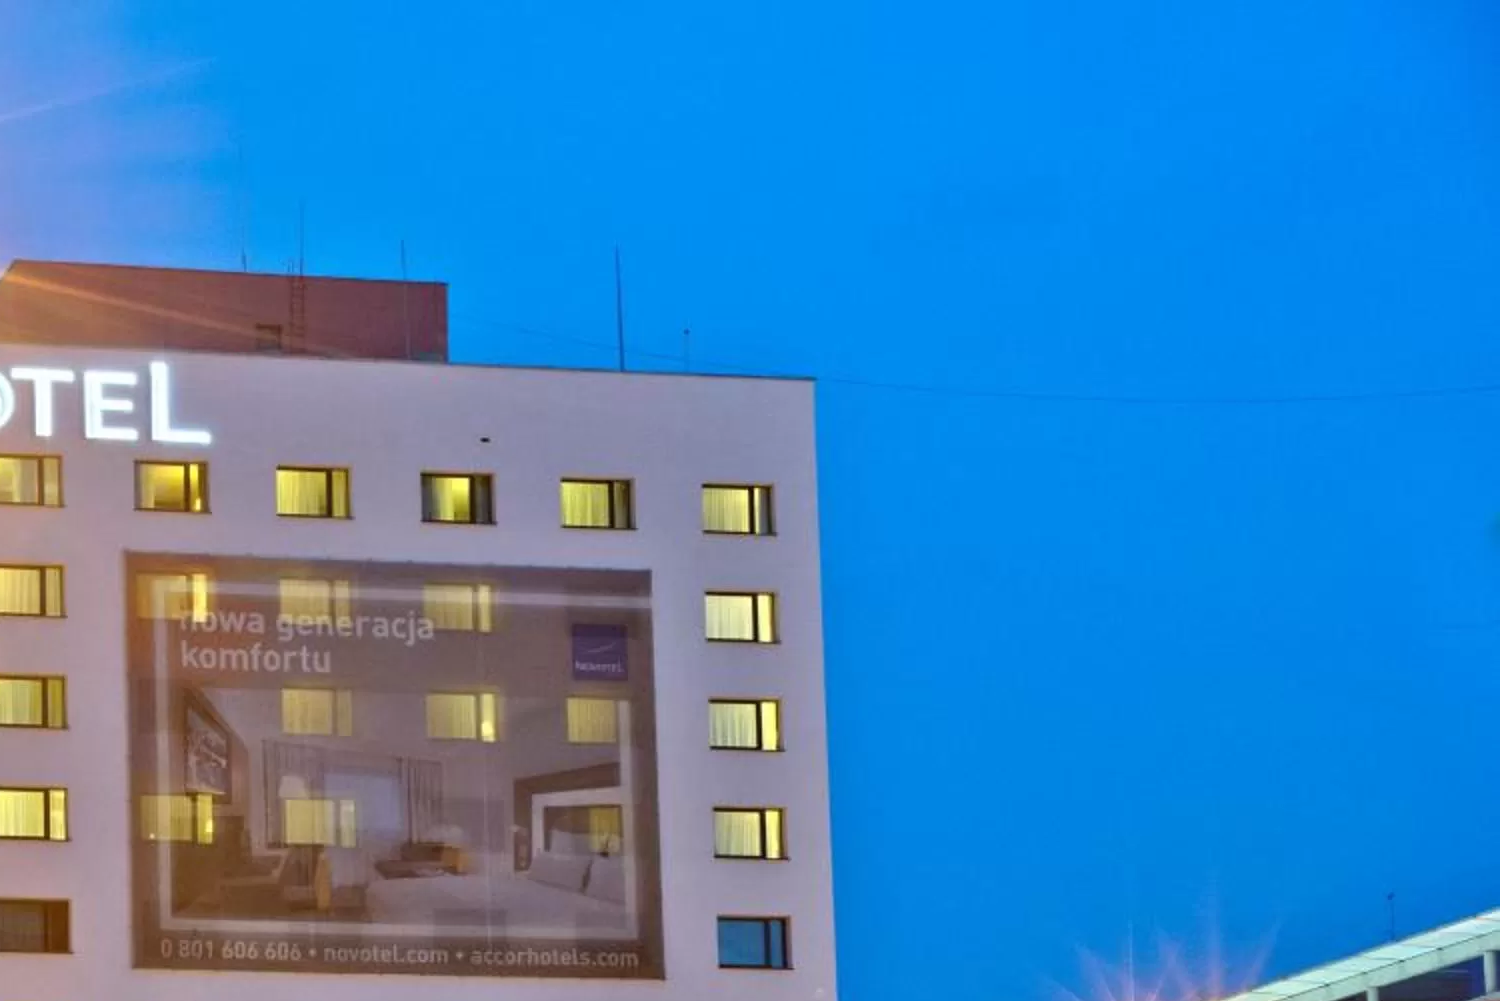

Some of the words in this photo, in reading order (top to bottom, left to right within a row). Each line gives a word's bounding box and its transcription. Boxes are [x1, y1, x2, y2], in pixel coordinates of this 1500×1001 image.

[180, 612, 265, 634] nowa
[276, 610, 434, 647] generacja
[181, 640, 331, 673] komfortu
[160, 938, 173, 959] 0
[179, 939, 213, 959] 801
[221, 940, 258, 960] 606
[264, 940, 302, 961] 606
[323, 944, 449, 965] novotel.com
[470, 947, 639, 968] accorhotels.com
